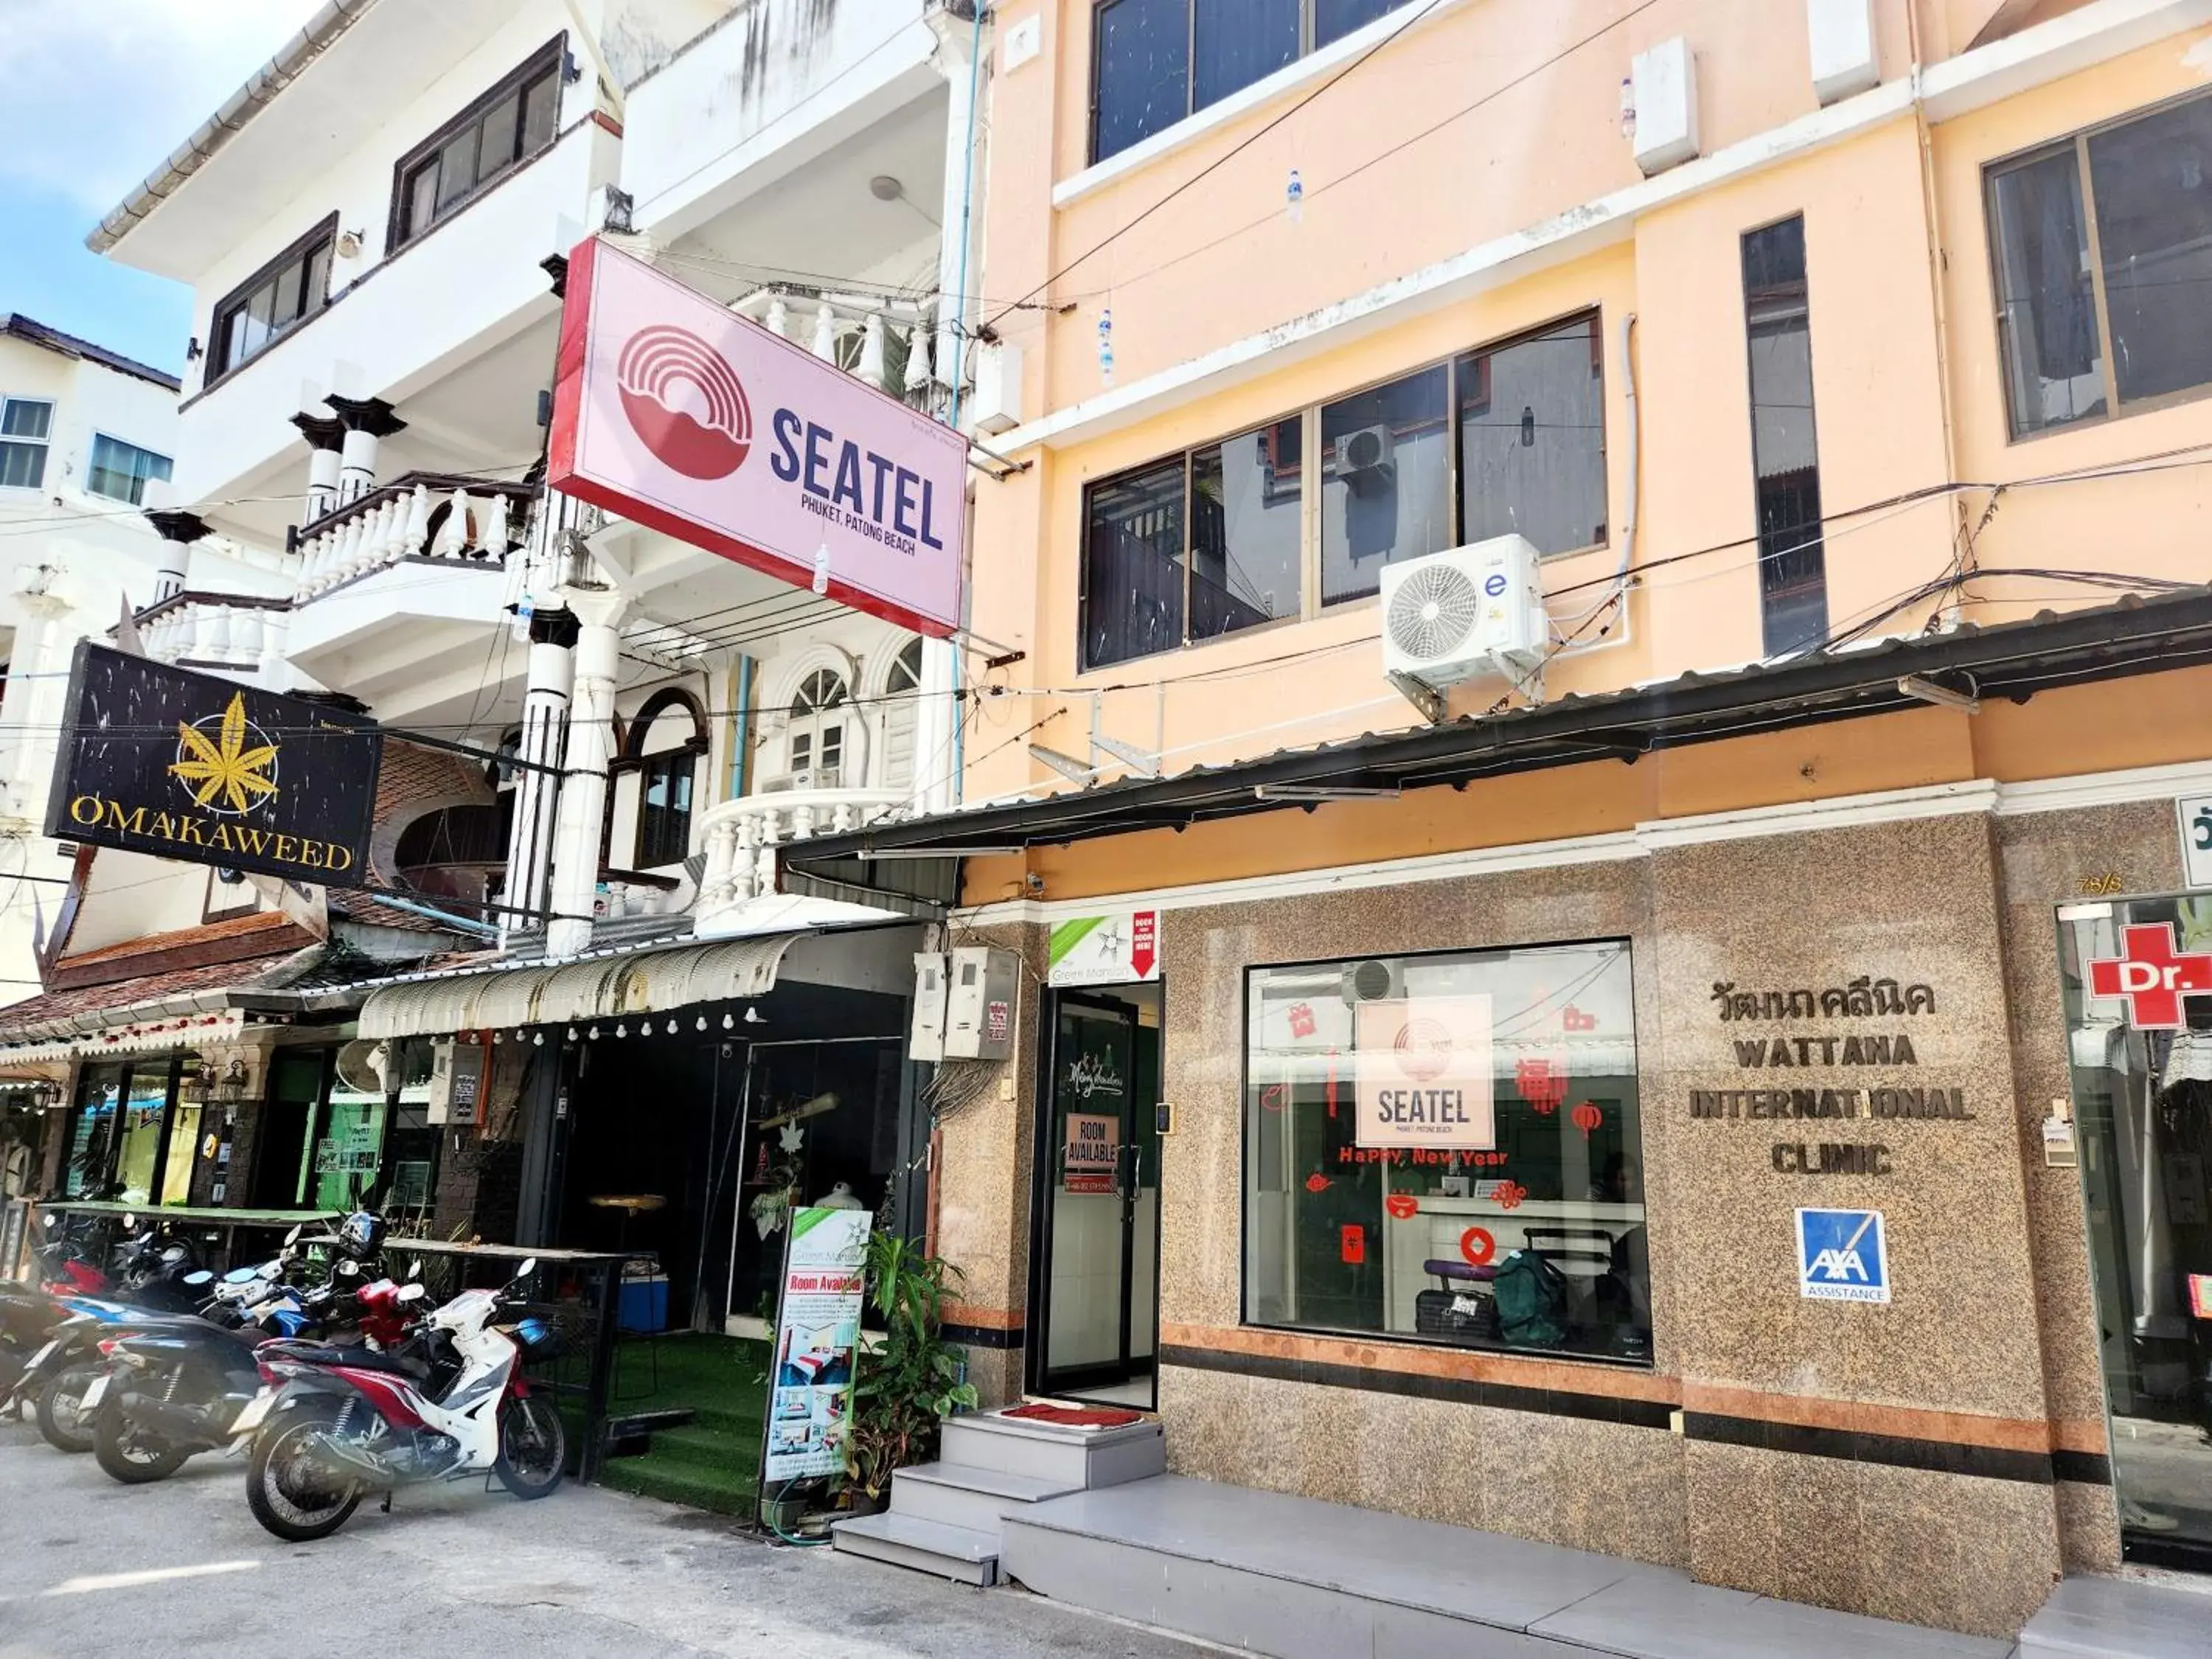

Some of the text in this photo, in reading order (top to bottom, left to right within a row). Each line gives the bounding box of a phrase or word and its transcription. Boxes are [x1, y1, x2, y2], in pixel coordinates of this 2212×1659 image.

[771, 408, 942, 551] SEATEL
[846, 512, 883, 543] PATONG
[885, 530, 916, 557] BEACH
[71, 796, 352, 872] OMAKAWEED
[2118, 961, 2193, 992] Dr.
[1733, 1034, 1917, 1068] WATTANA
[1378, 1089, 1470, 1123] SEATEL
[1689, 1088, 1977, 1120] INTERNATIONAL
[1080, 1121, 1105, 1141] ROOM
[1069, 1143, 1116, 1163] AVAILABLE
[1772, 1144, 1891, 1176] CLINIC
[1806, 1248, 1869, 1282] AXA
[790, 1275, 818, 1290] Room
[1808, 1286, 1885, 1301] ASSISTANCE
